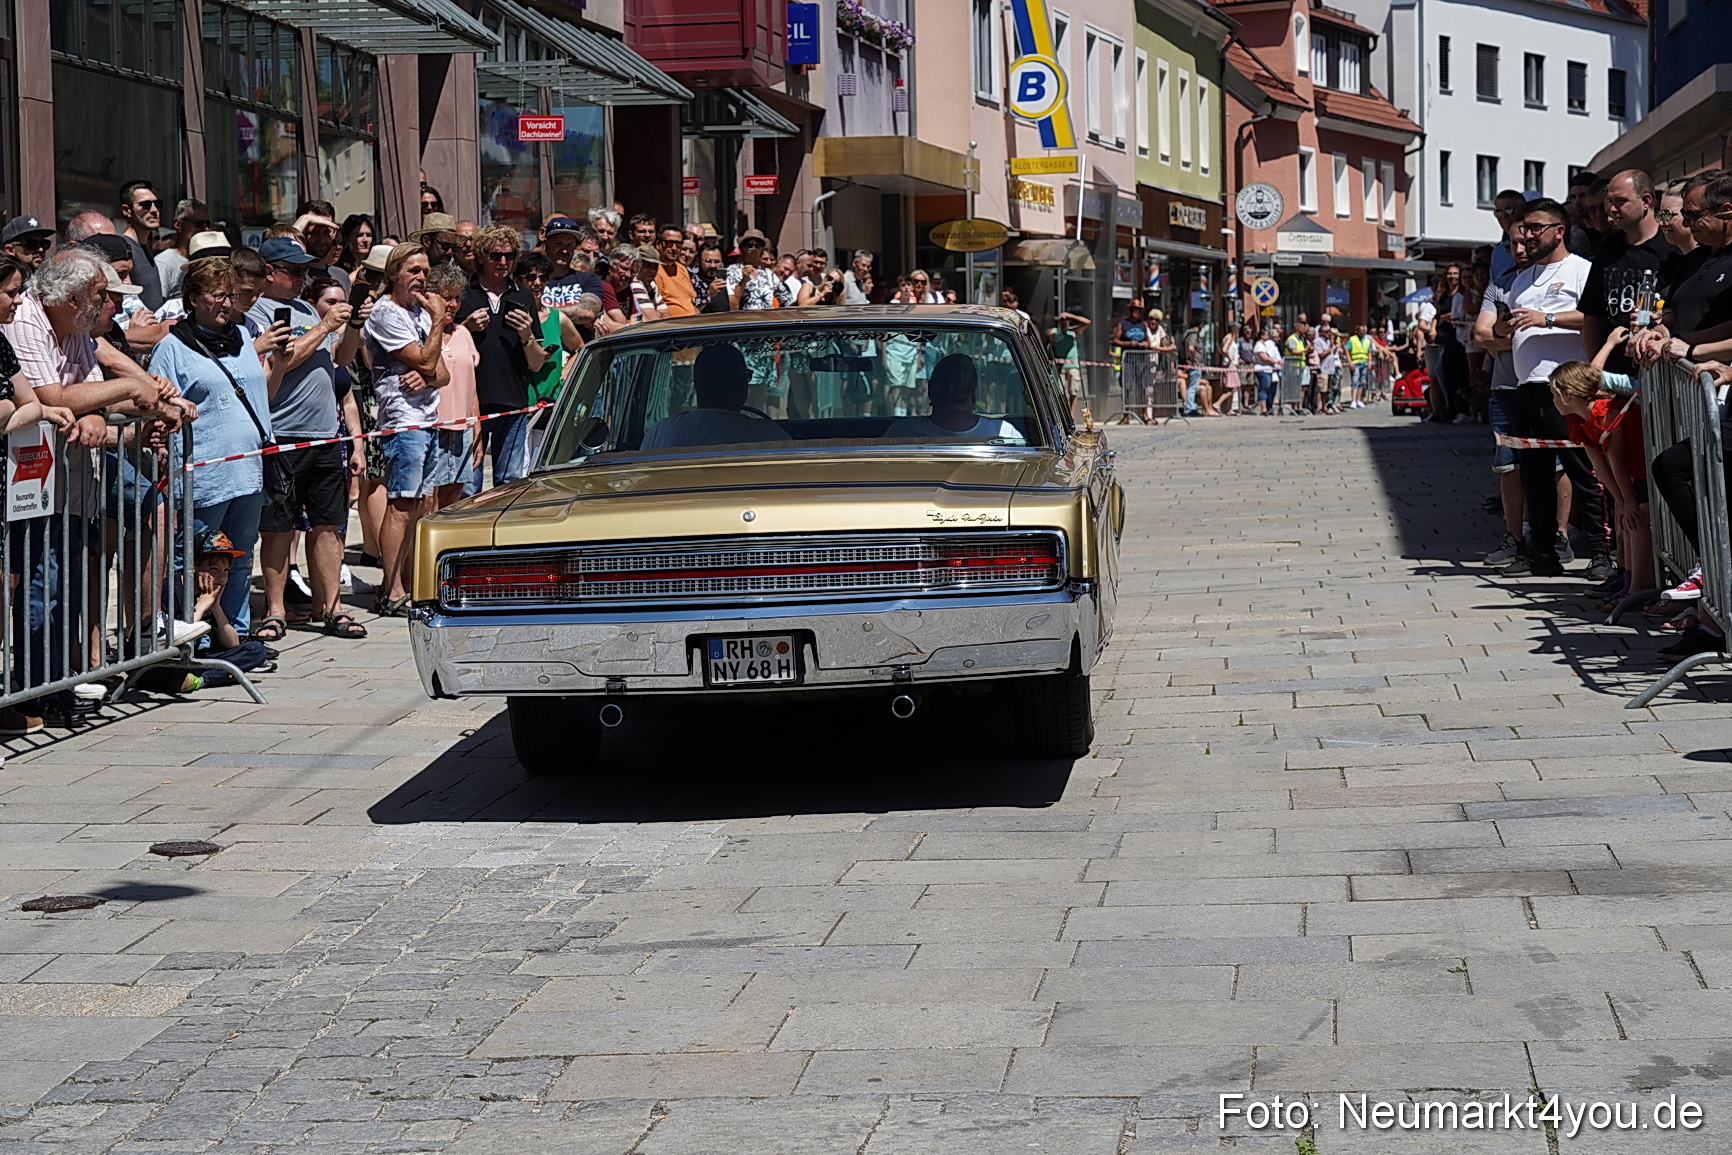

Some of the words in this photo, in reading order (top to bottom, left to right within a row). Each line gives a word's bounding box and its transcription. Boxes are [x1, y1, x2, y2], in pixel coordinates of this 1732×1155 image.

[1017, 71, 1046, 102] B
[526, 121, 556, 129] Vorsicht
[1014, 161, 1066, 170] KLOSTERGASSE
[796, 331, 903, 342] Germany
[16, 493, 35, 501] Neumarkter
[13, 502, 38, 513] Oldtimertreffen
[726, 640, 754, 659] RH
[714, 661, 741, 681] NY
